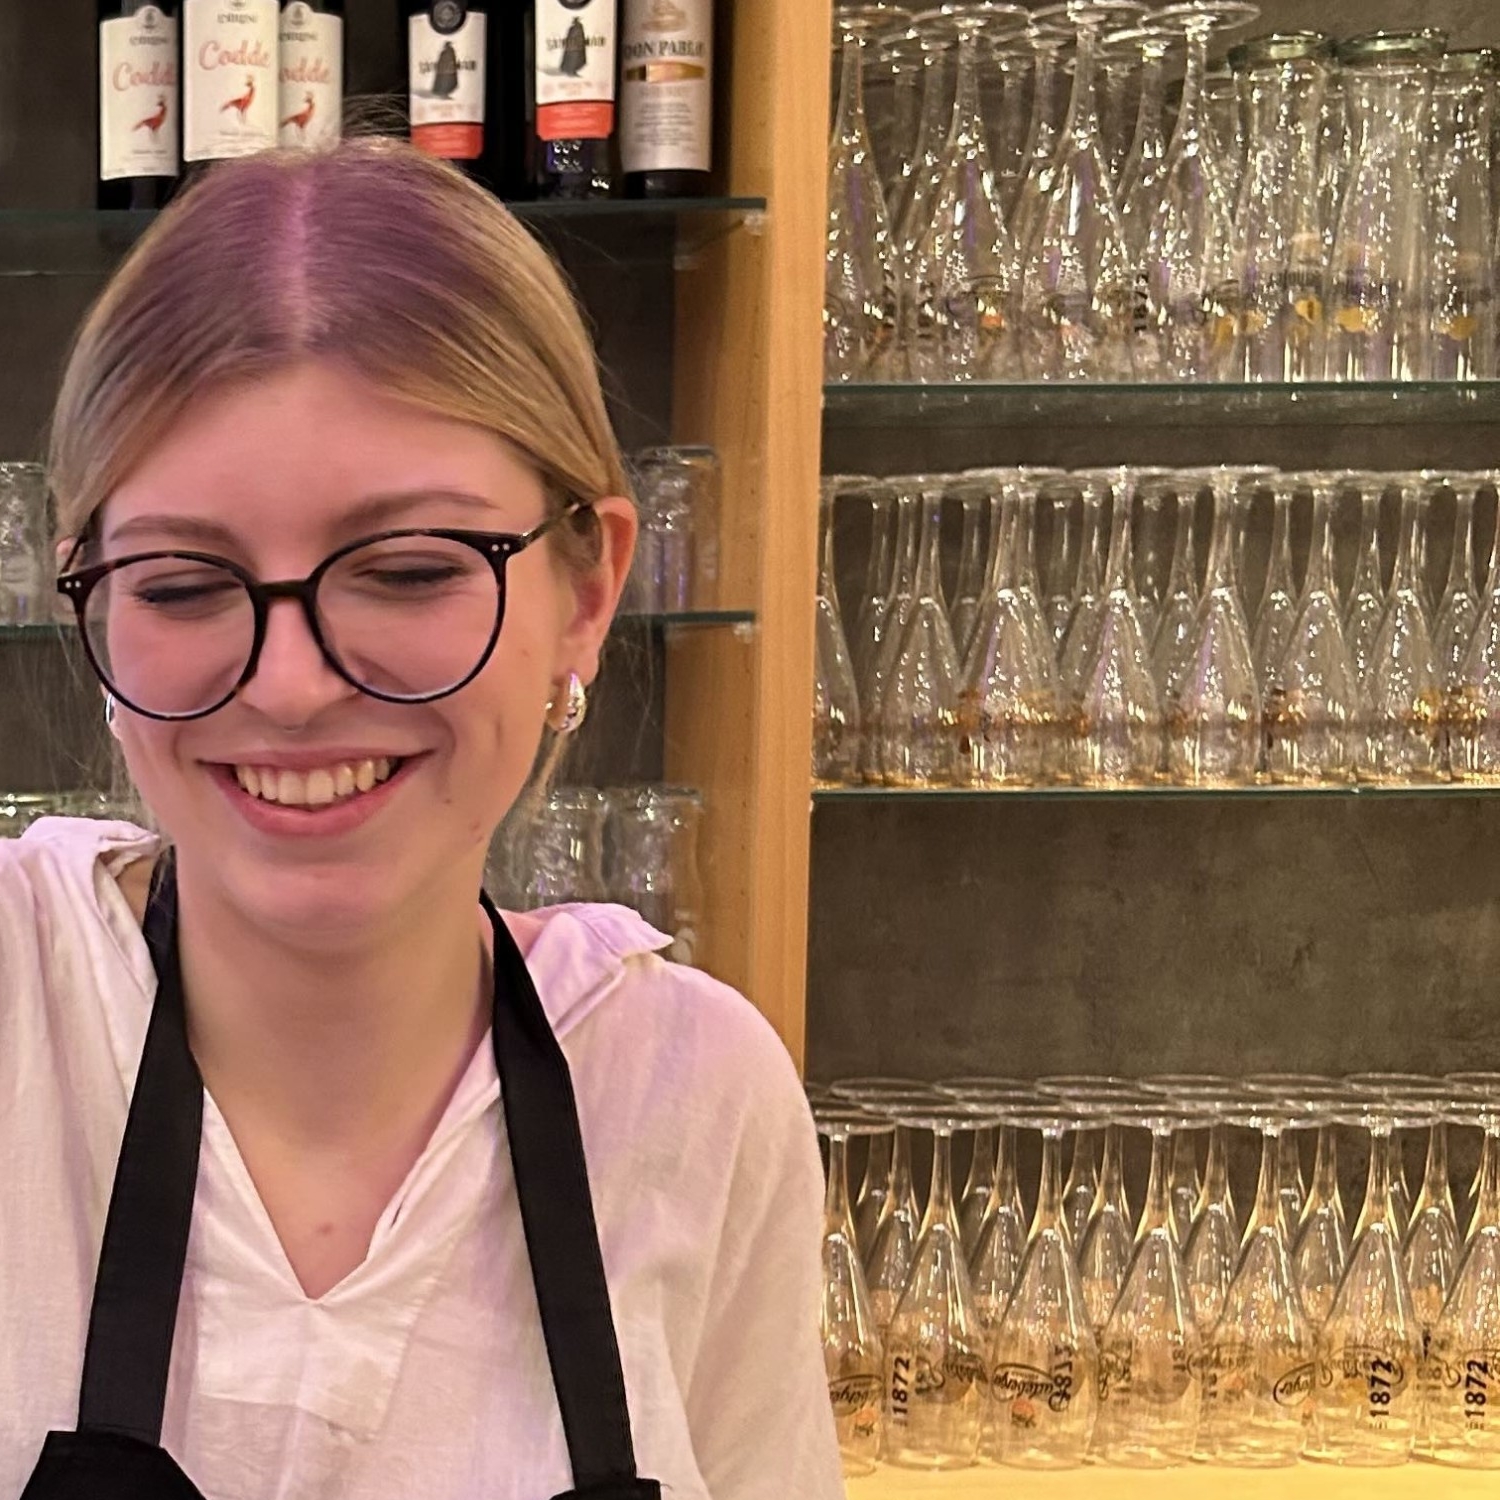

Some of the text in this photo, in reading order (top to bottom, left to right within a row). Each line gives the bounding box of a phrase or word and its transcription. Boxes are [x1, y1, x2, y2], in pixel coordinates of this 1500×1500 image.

[891, 1355, 910, 1415] 1872
[1369, 1358, 1393, 1418] 1872
[1464, 1359, 1488, 1418] 1872
